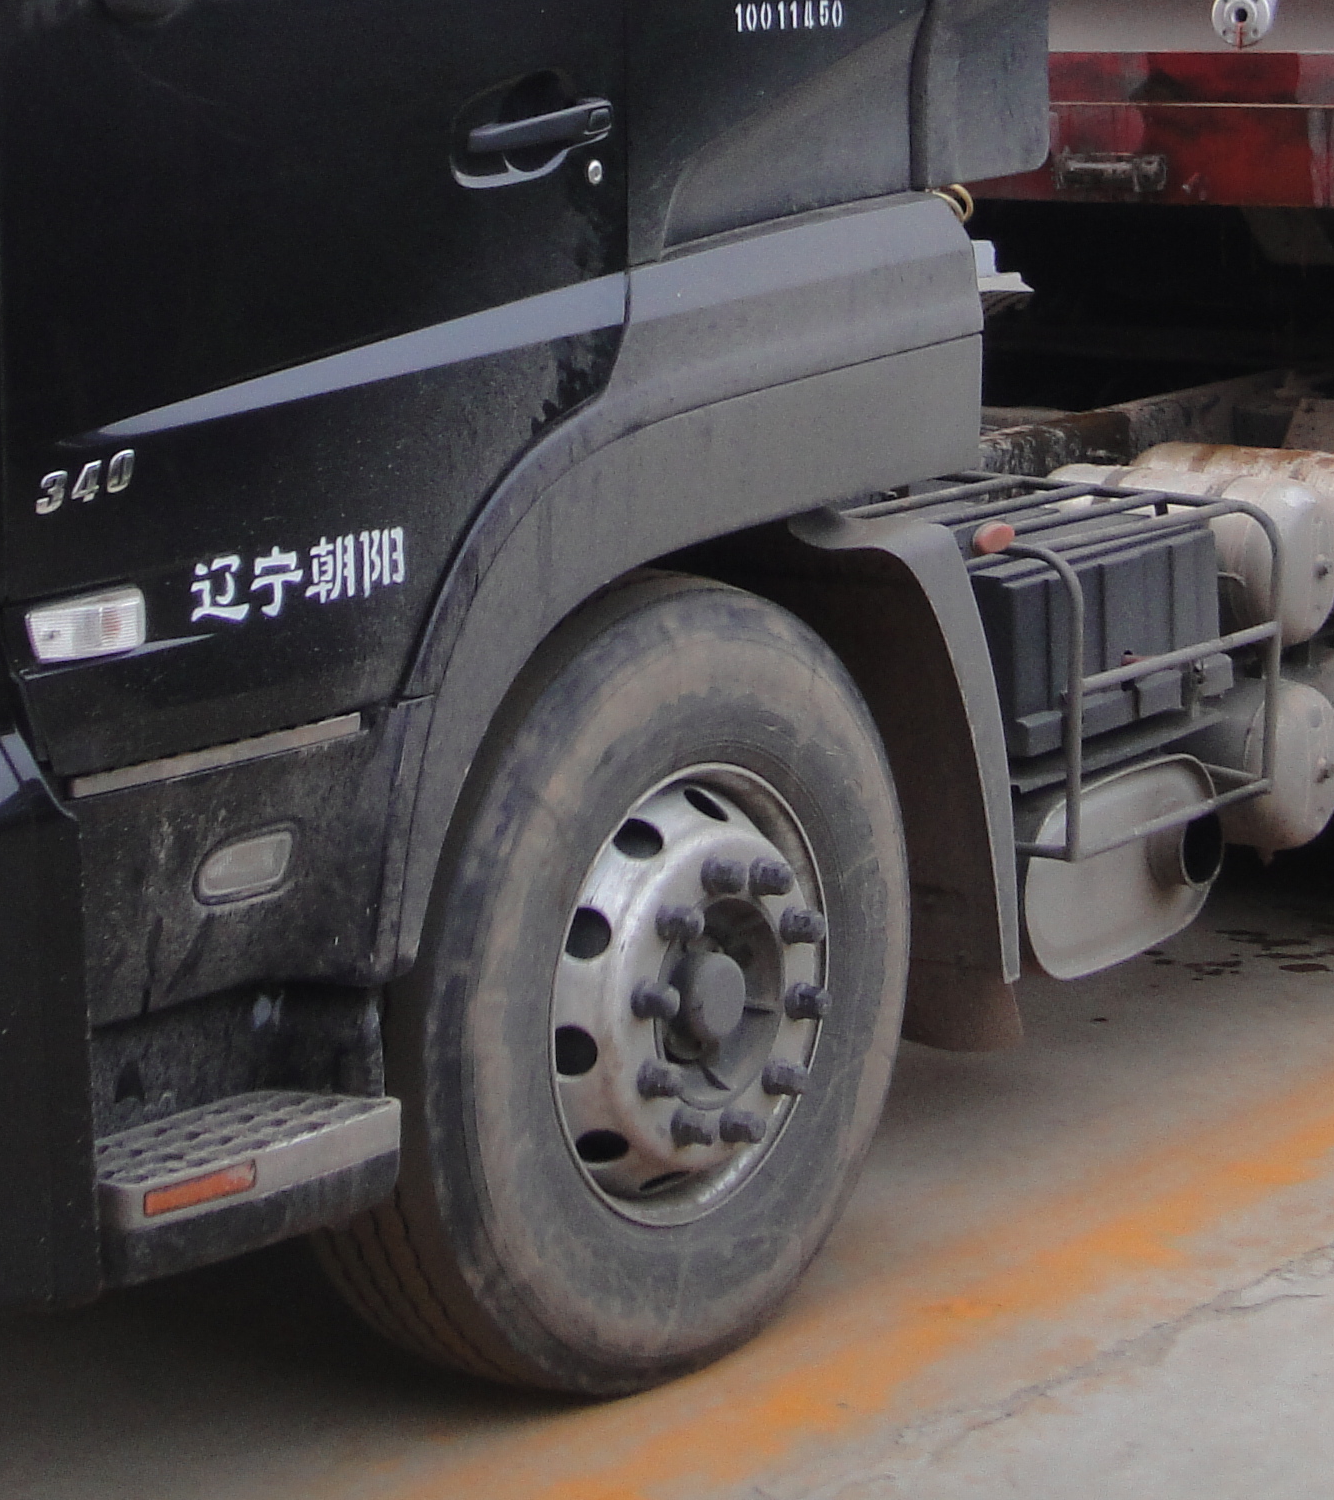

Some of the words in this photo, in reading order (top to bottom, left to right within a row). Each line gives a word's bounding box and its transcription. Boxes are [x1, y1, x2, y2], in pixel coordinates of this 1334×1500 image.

[734, 0, 844, 32] 10011450
[34, 448, 136, 516] 340
[189, 526, 405, 623] 辽宁朝阳
